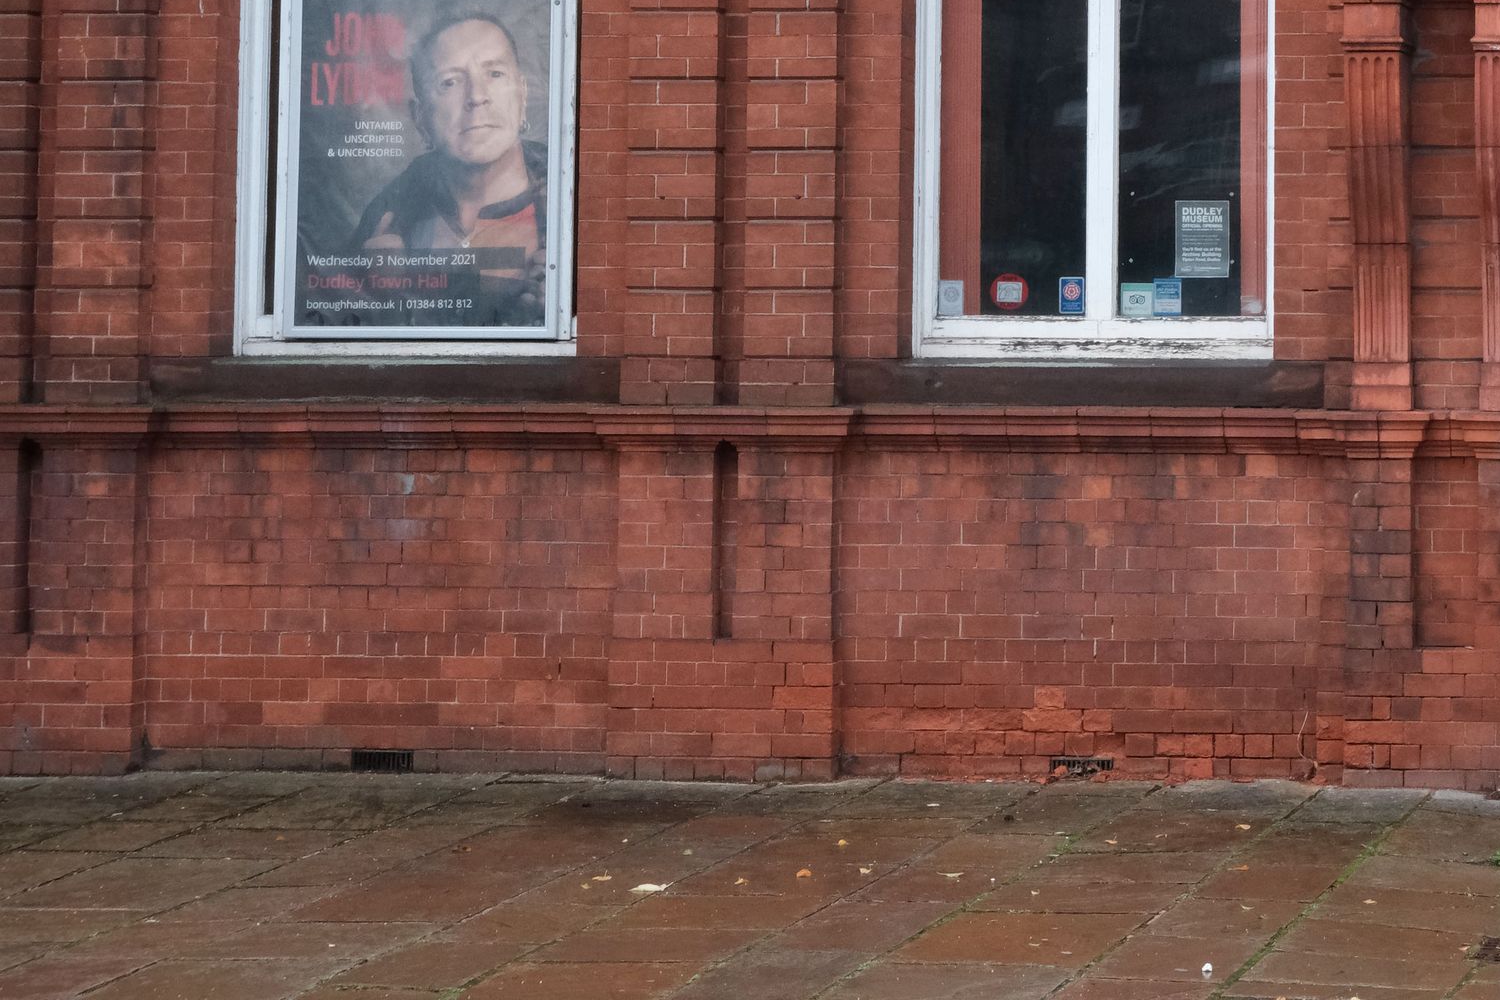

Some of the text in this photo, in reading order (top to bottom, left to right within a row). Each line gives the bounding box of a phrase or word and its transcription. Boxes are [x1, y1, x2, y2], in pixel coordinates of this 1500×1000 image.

[354, 121, 404, 131] UNTAMED,
[344, 134, 404, 144] UNSCRIPTED,
[327, 148, 335, 158] &
[1182, 207, 1223, 215] DUDLEY
[1182, 215, 1223, 223] MUSEUM
[306, 254, 476, 269] Wednesday 3 November 2021
[308, 273, 448, 293] Dudley Town Hall
[306, 299, 395, 311] boroughhalls.co.uk
[406, 299, 435, 309] 01384
[437, 299, 454, 309] 812
[455, 298, 473, 309] 812
